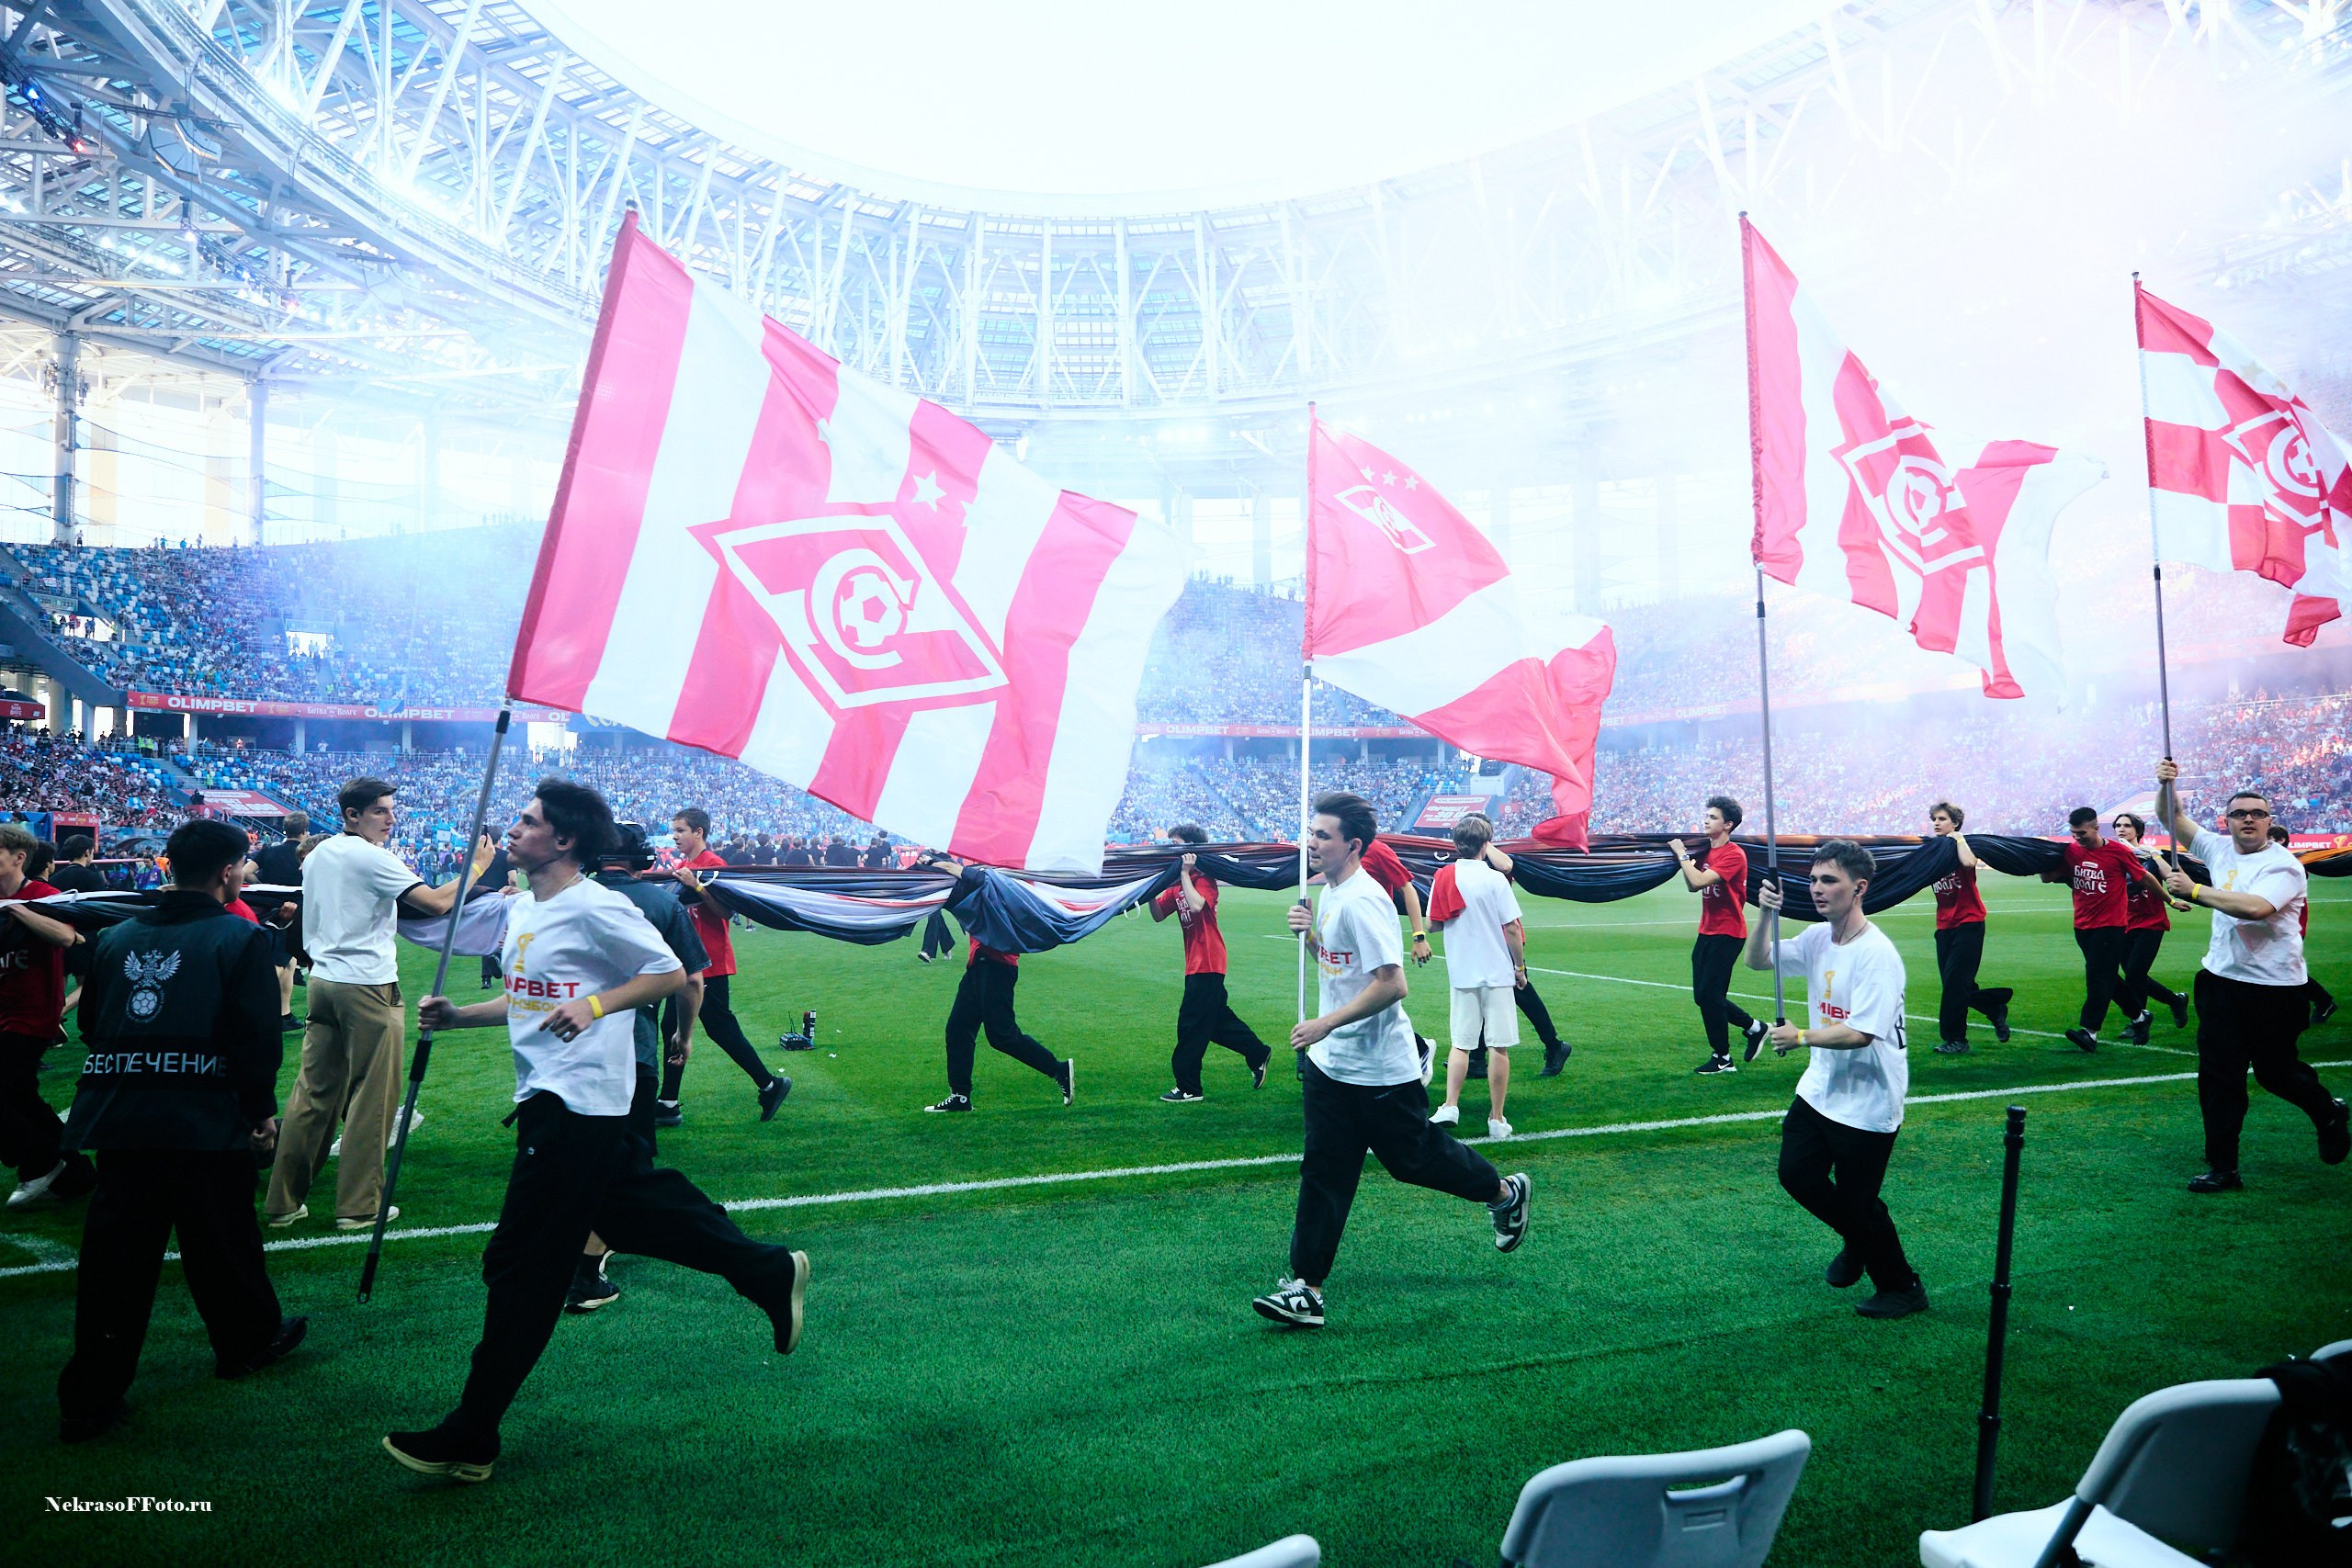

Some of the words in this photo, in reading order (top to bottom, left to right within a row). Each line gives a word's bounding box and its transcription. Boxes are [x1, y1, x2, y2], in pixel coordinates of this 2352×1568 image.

[167, 696, 258, 713] OLIMPBET
[1675, 705, 1728, 717] OLIMPBET
[1600, 716, 1624, 727] PBET
[1166, 725, 1229, 735] OLIMPBET
[1295, 728, 1359, 737] OIMPBET
[82, 1052, 227, 1077] БЕСПЕЧЕНИЕ
